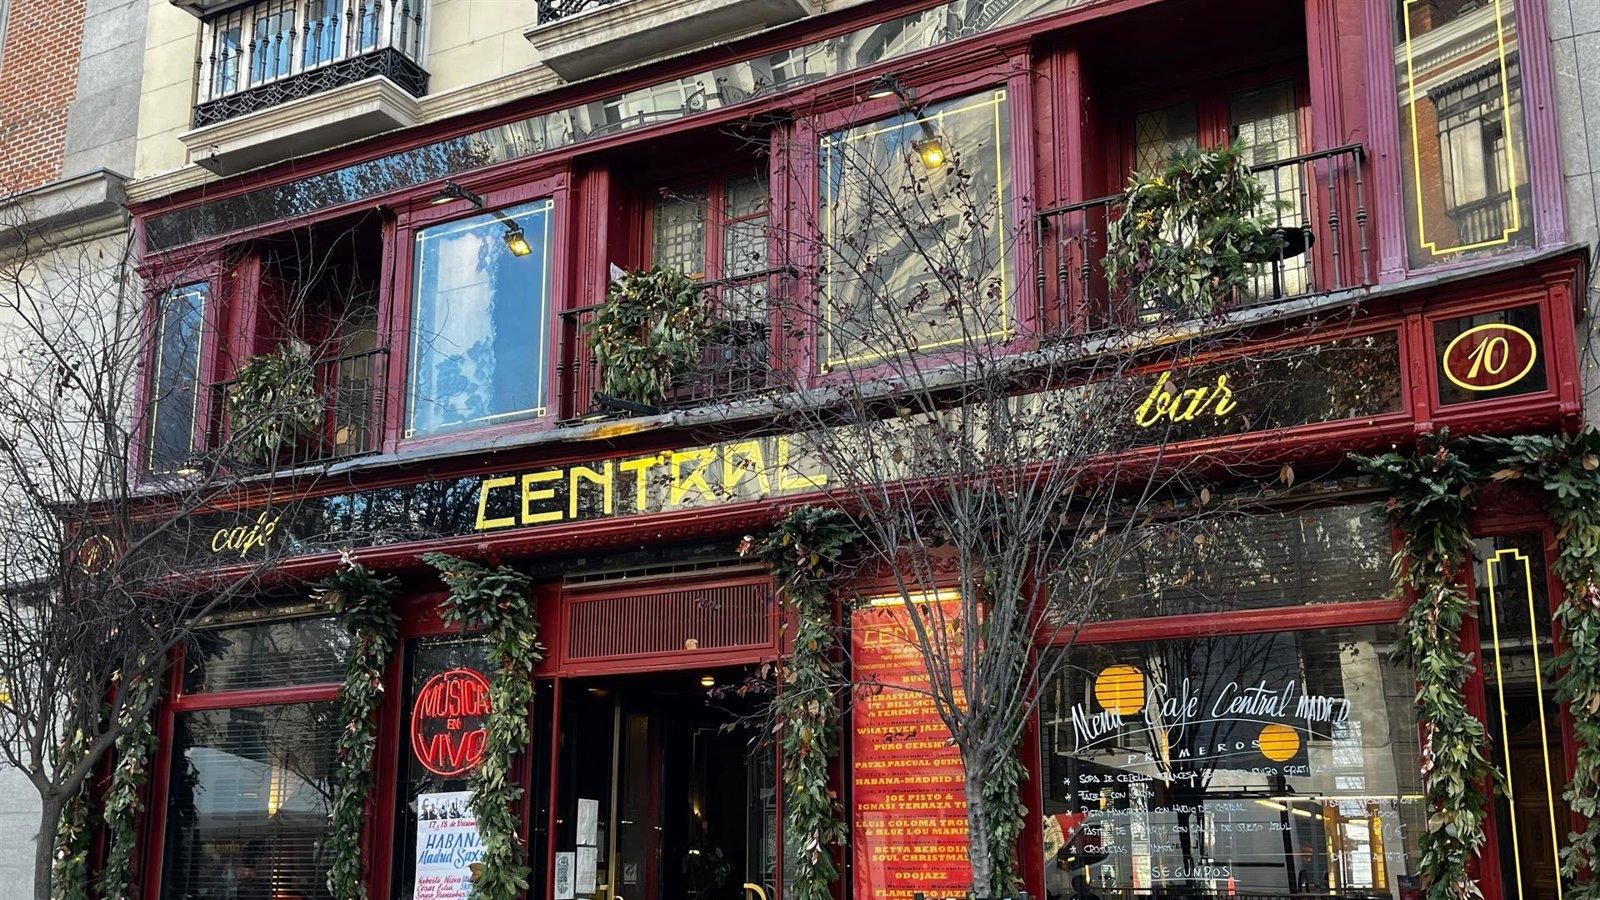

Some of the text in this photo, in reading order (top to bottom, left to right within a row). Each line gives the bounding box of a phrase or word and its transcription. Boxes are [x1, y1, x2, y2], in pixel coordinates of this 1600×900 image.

[1467, 337, 1509, 379] 10
[1135, 371, 1236, 428] bar
[475, 437, 827, 530] CENTRAL
[212, 511, 280, 557] café
[887, 700, 911, 709] BILL
[878, 708, 920, 717] FERENC
[1145, 677, 1200, 749] Café
[1211, 680, 1295, 718] Central
[447, 719, 461, 730] EN
[920, 724, 948, 733] JAZZ
[418, 730, 486, 767] VIVO
[874, 743, 903, 751] PURO
[887, 759, 931, 768] PASCUAL
[856, 775, 953, 785] HABANA-MADRID
[1079, 774, 1100, 784] SOPA
[1103, 774, 1114, 783] DE
[1117, 773, 1154, 783] CEBOLLA
[885, 794, 906, 803] JOE
[908, 793, 942, 802] PISTO
[1110, 791, 1126, 799] CON
[858, 803, 896, 811] IGNASI
[898, 801, 951, 810] TERRAZA
[888, 818, 936, 827] COLOMA
[876, 828, 904, 836] BLUE
[906, 827, 930, 835] LOU
[874, 845, 911, 854] BETTA
[871, 854, 900, 862] SOUL
